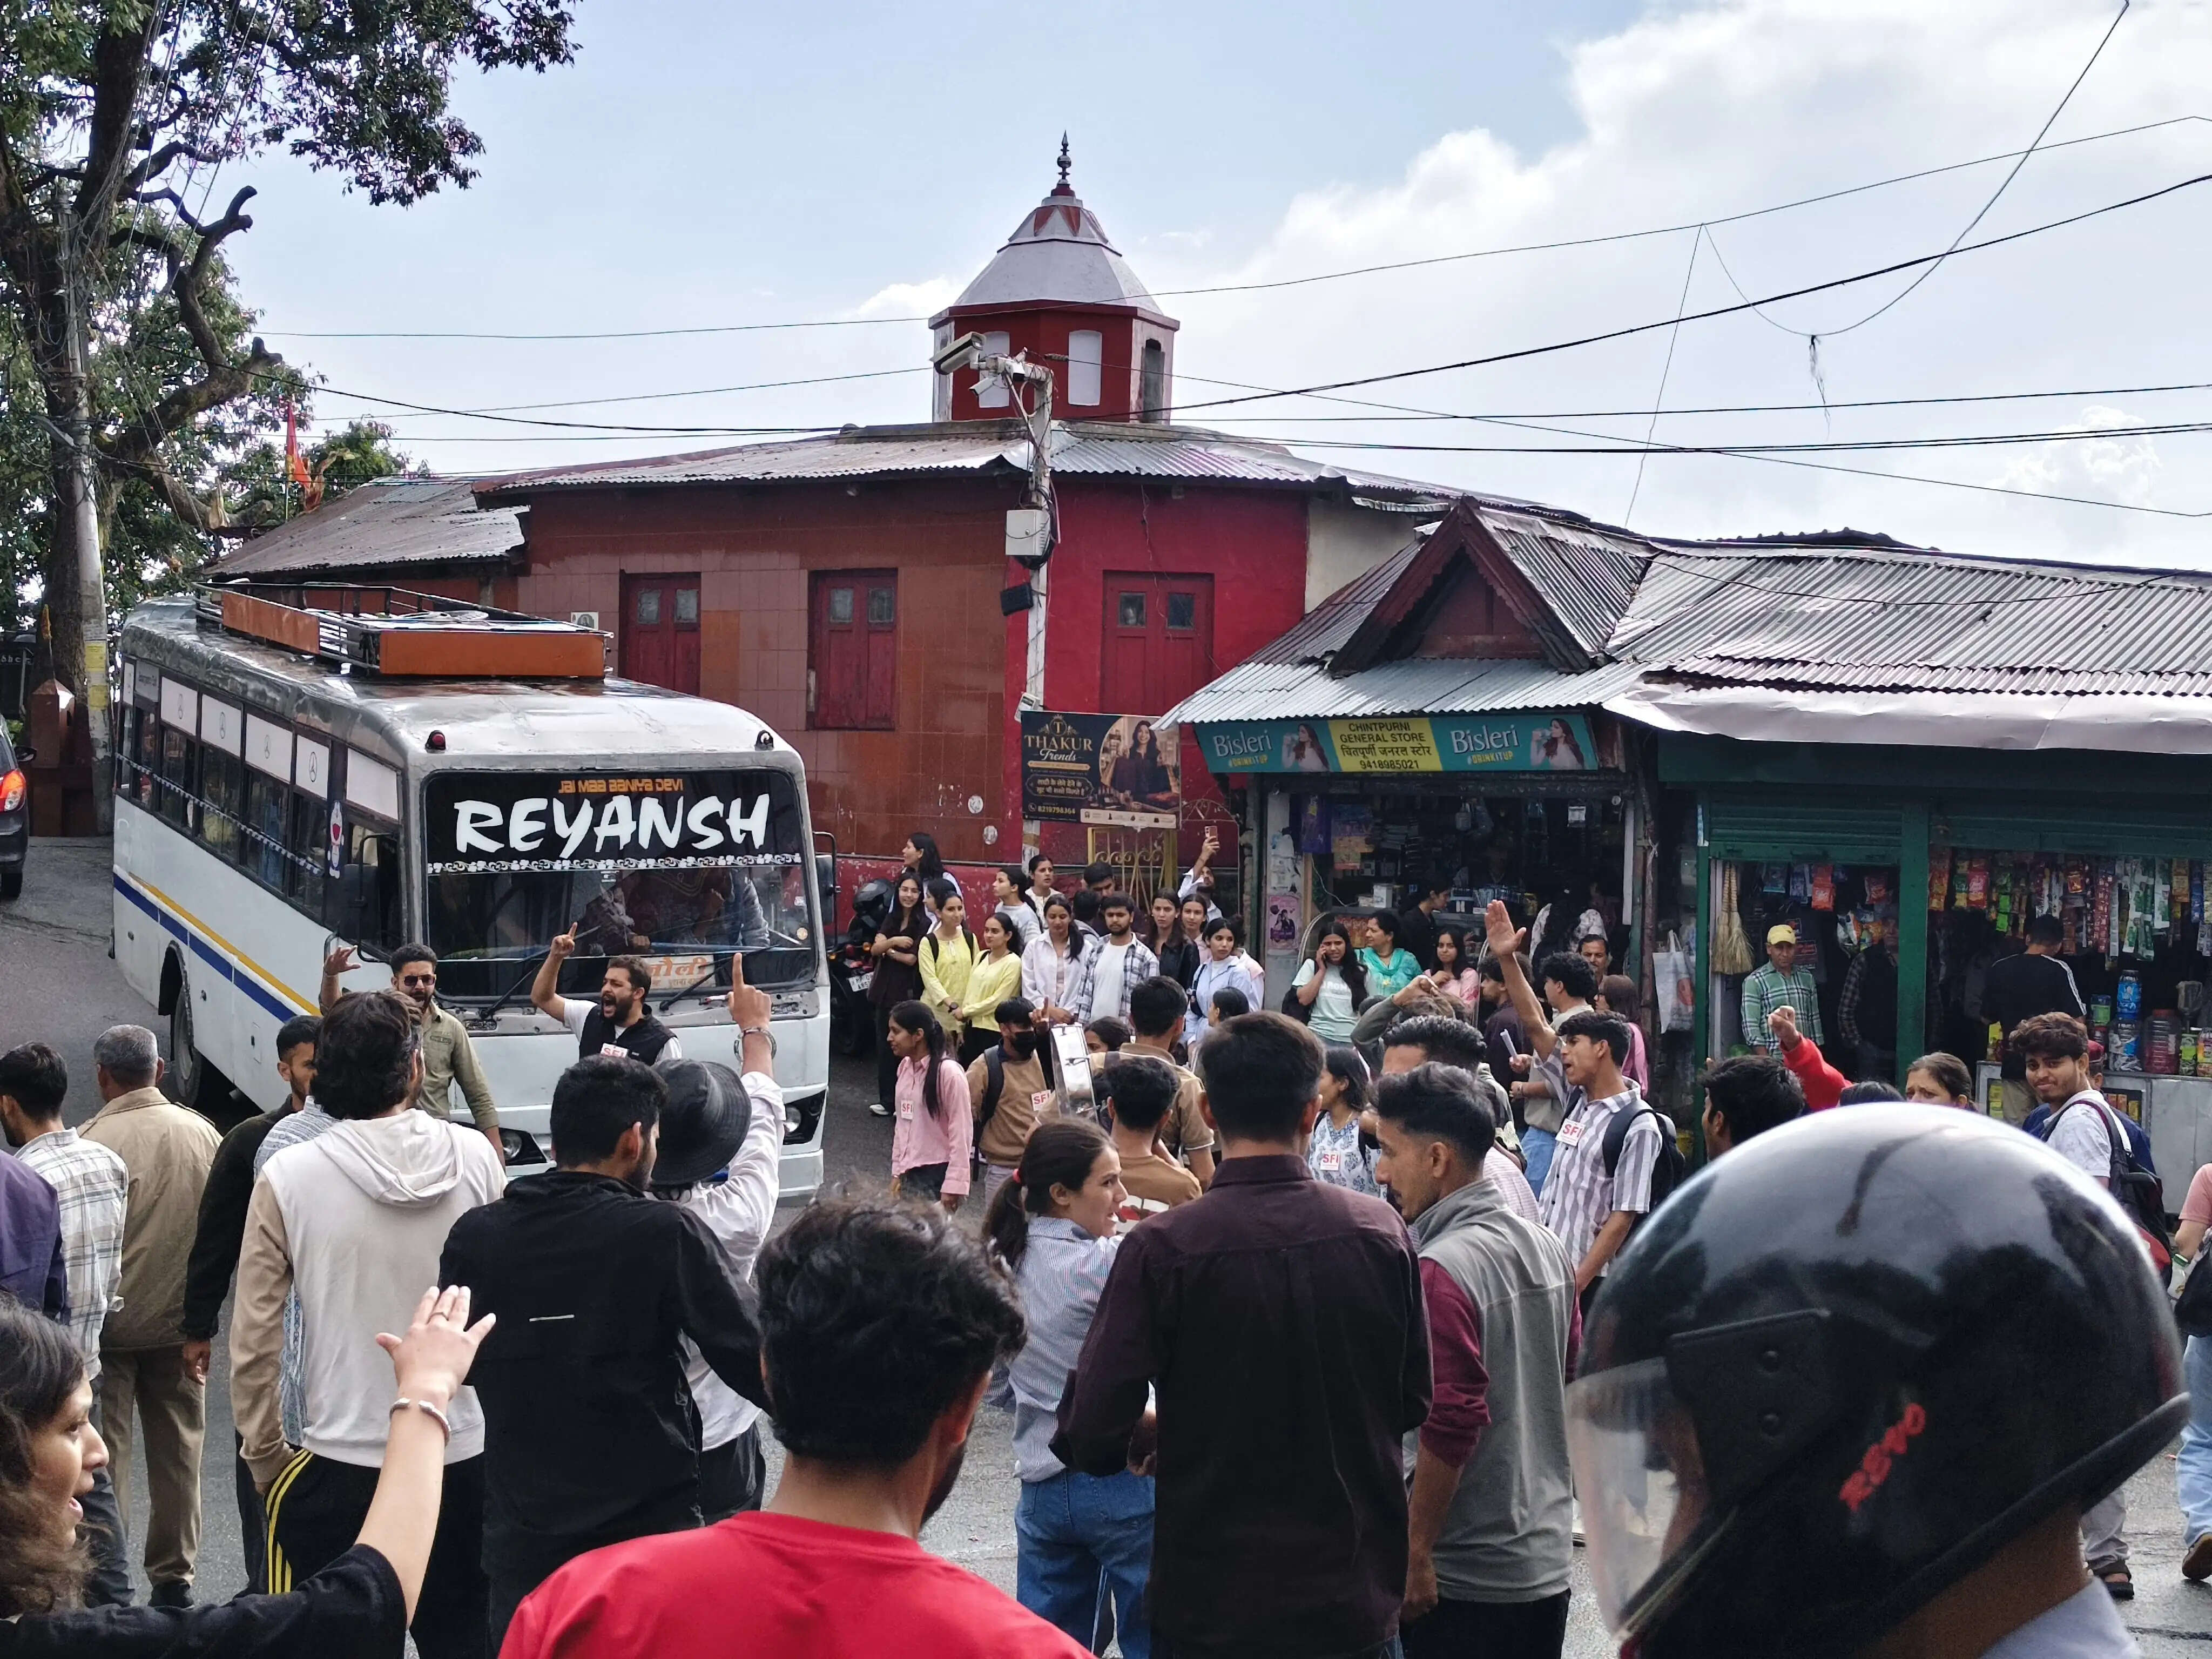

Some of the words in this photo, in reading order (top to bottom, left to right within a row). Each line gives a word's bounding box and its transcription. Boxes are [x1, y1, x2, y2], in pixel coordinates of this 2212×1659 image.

[1348, 722, 1411, 732] CHINTPURNI
[1024, 735, 1092, 751] THAKUR
[1213, 730, 1272, 757] Bisleri
[1340, 734, 1388, 743] GENERAL
[1391, 733, 1426, 742] STORE
[1450, 724, 1519, 754] Bisleri
[1040, 748, 1076, 761] Trends
[1378, 746, 1408, 756] जनरल
[1410, 743, 1432, 756] स्टोर
[1360, 760, 1419, 770] 9418985021
[454, 794, 770, 859] REYANSH
[902, 1103, 913, 1112] SFI
[1563, 1124, 1582, 1138] SFI
[1323, 1154, 1339, 1163] SFI
